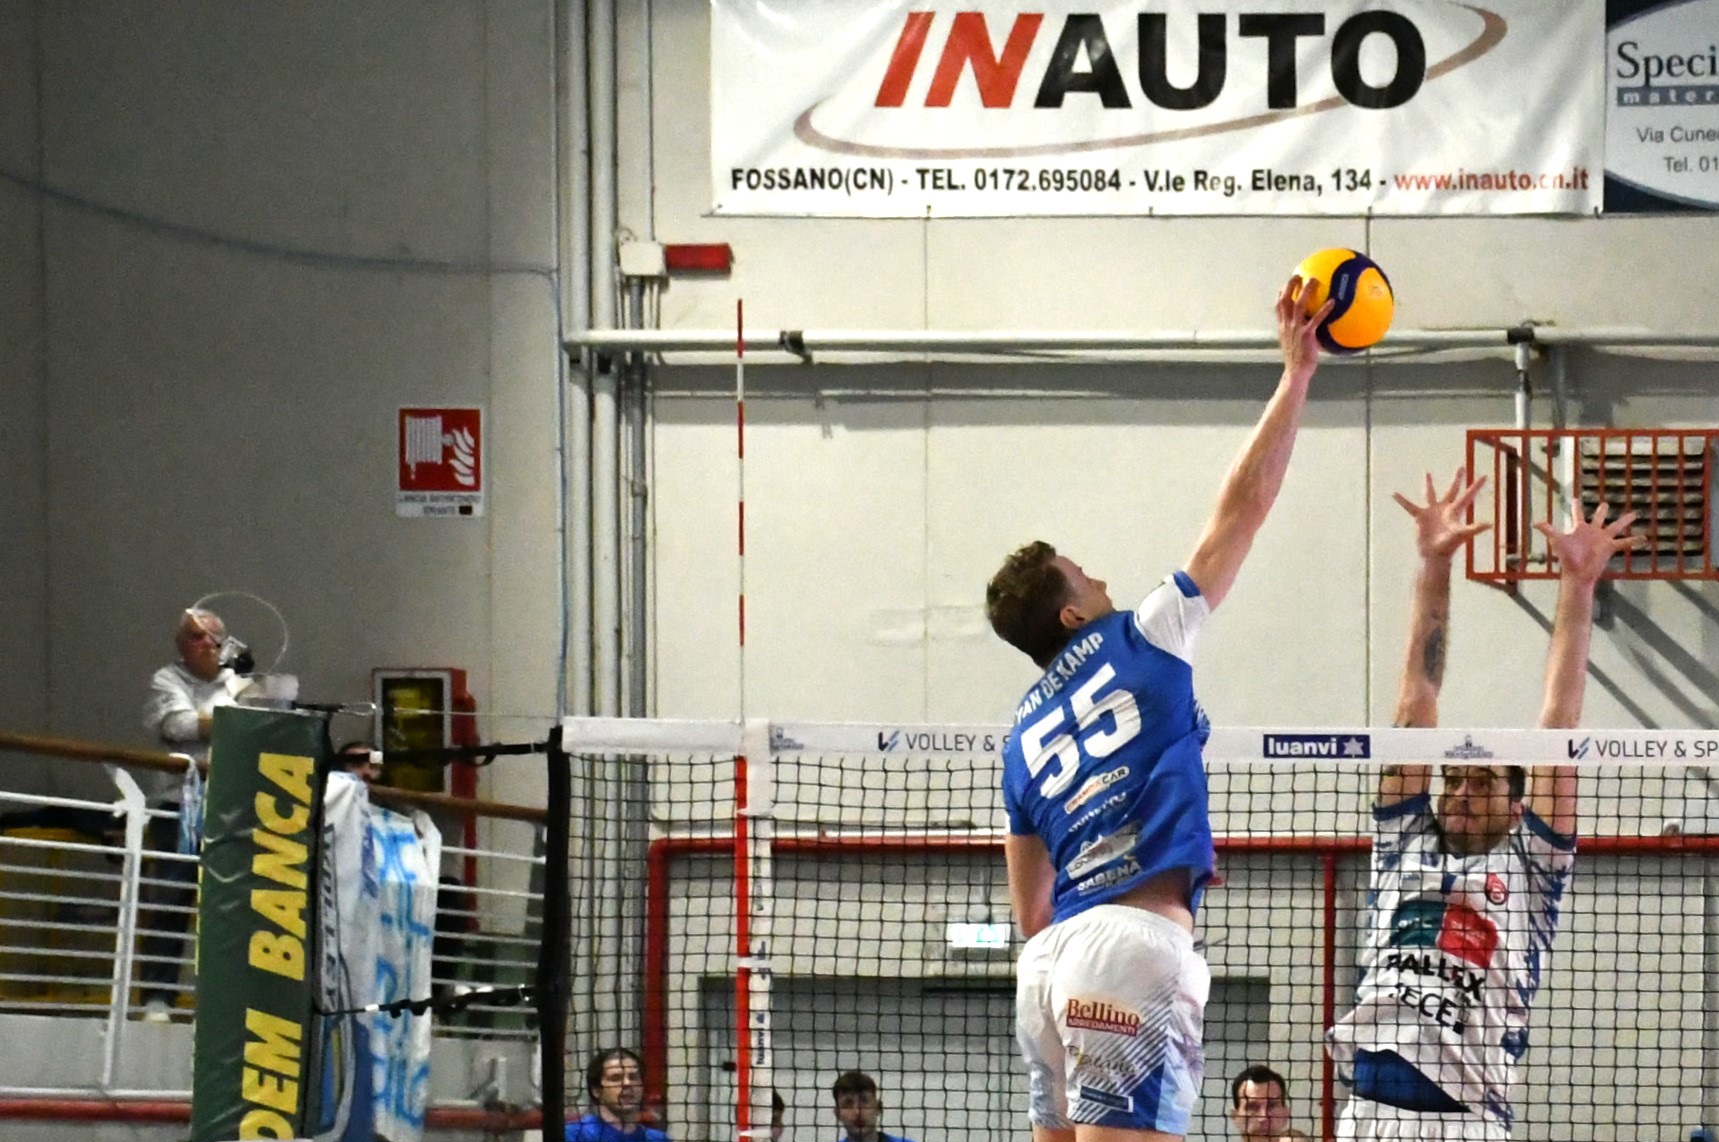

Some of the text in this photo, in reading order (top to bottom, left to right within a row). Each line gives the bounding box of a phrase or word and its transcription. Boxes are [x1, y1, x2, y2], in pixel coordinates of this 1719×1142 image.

[874, 9, 1427, 112] INAUTO
[1637, 127, 1665, 144] Via
[1664, 155, 1693, 173] Tel.
[731, 168, 895, 195] FOSSANO(CN)
[916, 168, 966, 191] TEL.
[973, 168, 1122, 192] 0172.695084
[1143, 169, 1186, 192] V.le
[1193, 169, 1243, 197] Reg.
[1251, 168, 1323, 197] Elena,
[1331, 168, 1372, 192] 134
[1055, 632, 1104, 681] KAMP
[906, 732, 996, 752] VOLLEY &
[1020, 662, 1142, 799] 55
[1266, 736, 1338, 757] luanvi
[1596, 738, 1669, 759] VOLLEY
[1674, 738, 1689, 758] &
[248, 752, 315, 981] BANCA
[1067, 998, 1140, 1027] Bellino
